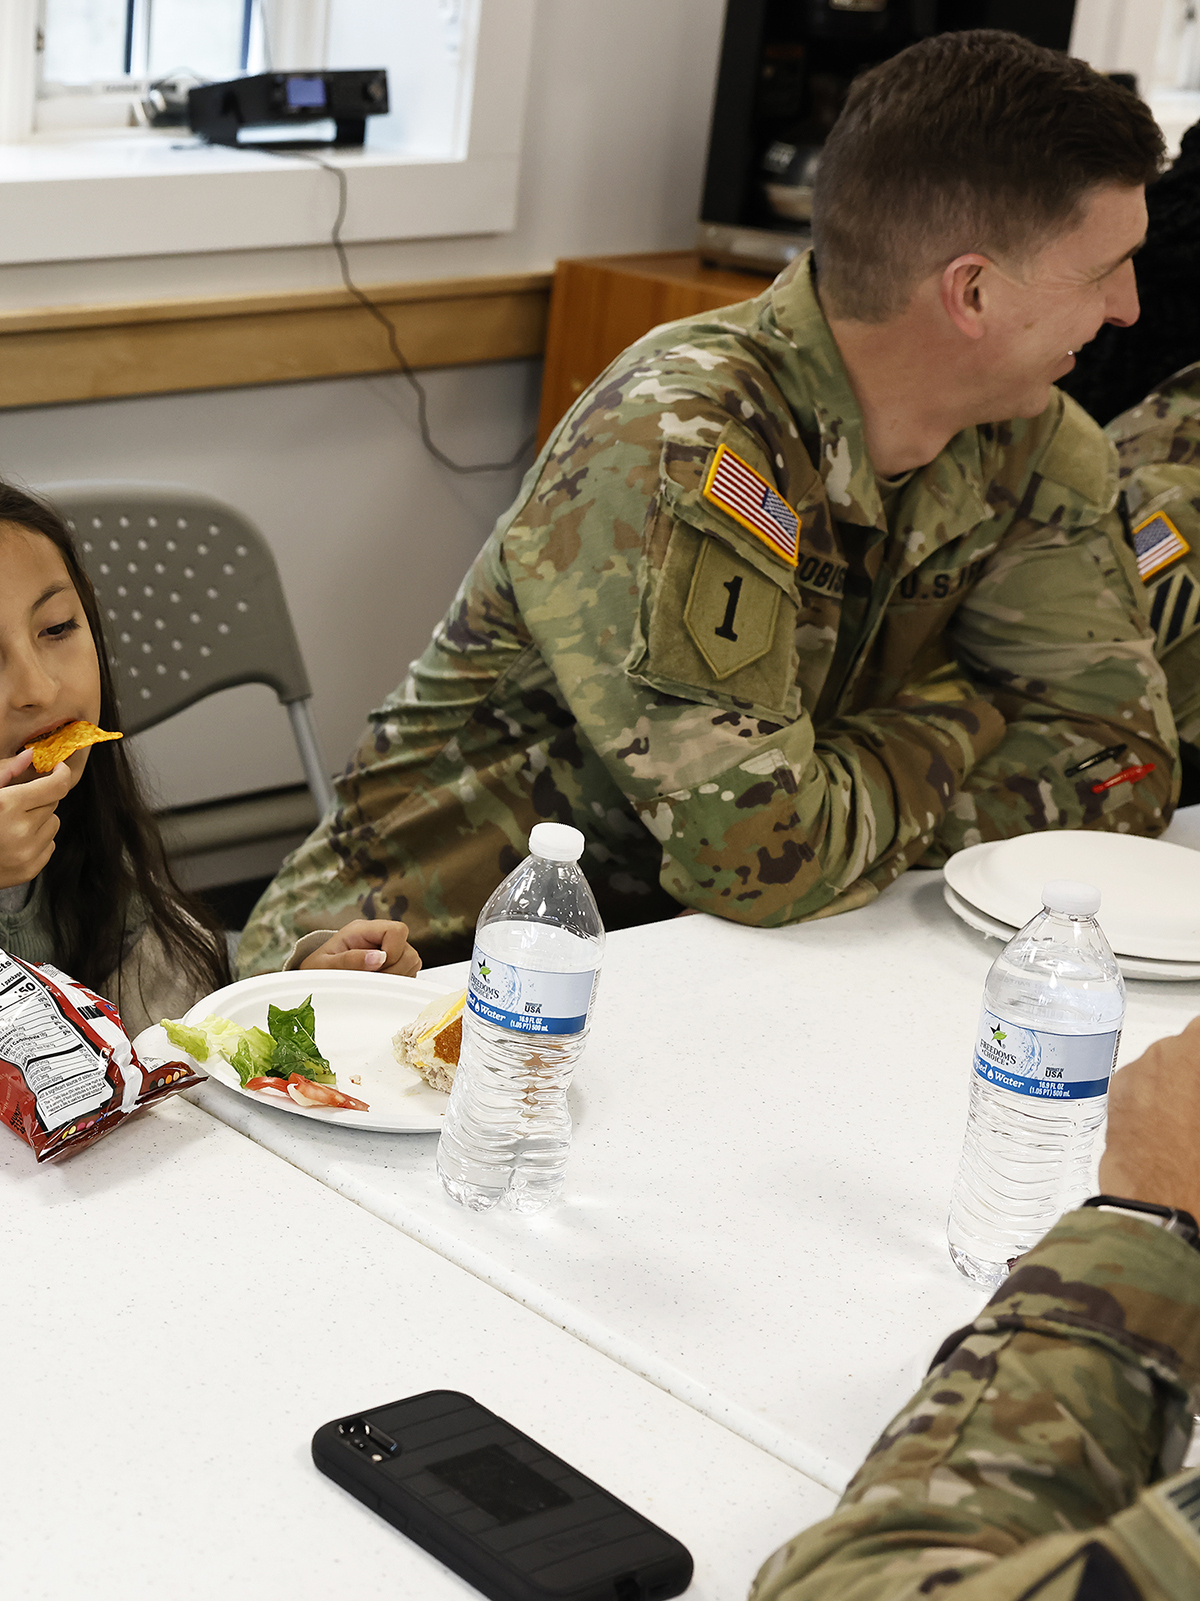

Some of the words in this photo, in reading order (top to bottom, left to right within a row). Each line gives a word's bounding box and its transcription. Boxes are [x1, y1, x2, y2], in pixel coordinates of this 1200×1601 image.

[715, 575, 743, 642] 1
[4, 972, 22, 986] package
[480, 1004, 506, 1021] Water
[980, 1039, 1016, 1064] FREEDOM'S
[983, 1050, 1005, 1065] CHOICE
[995, 1071, 1024, 1088] Water
[1029, 1086, 1042, 1095] (1.05
[1043, 1089, 1052, 1097] PT)
